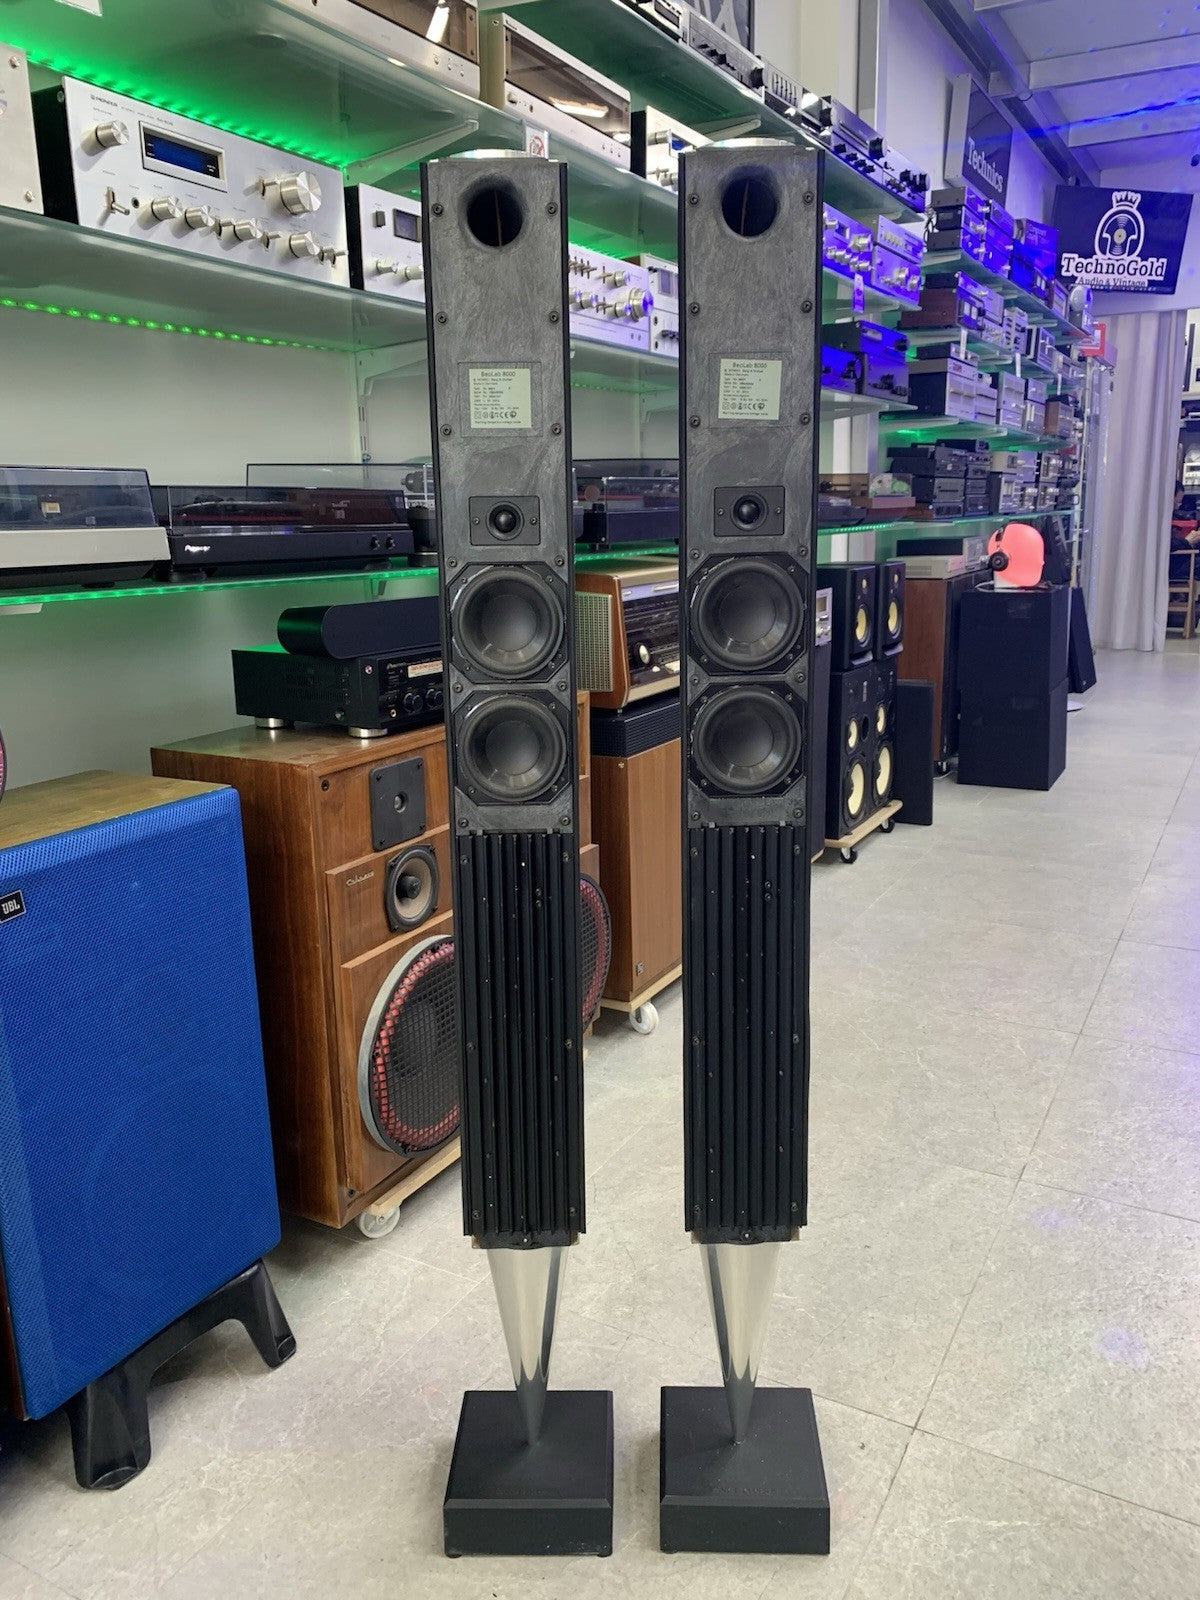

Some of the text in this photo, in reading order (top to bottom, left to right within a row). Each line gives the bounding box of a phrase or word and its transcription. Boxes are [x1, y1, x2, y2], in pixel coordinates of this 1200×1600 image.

[968, 137, 1003, 194] Technics
[1063, 257, 1164, 278] TechnoGold
[1, 899, 17, 914] JBL
